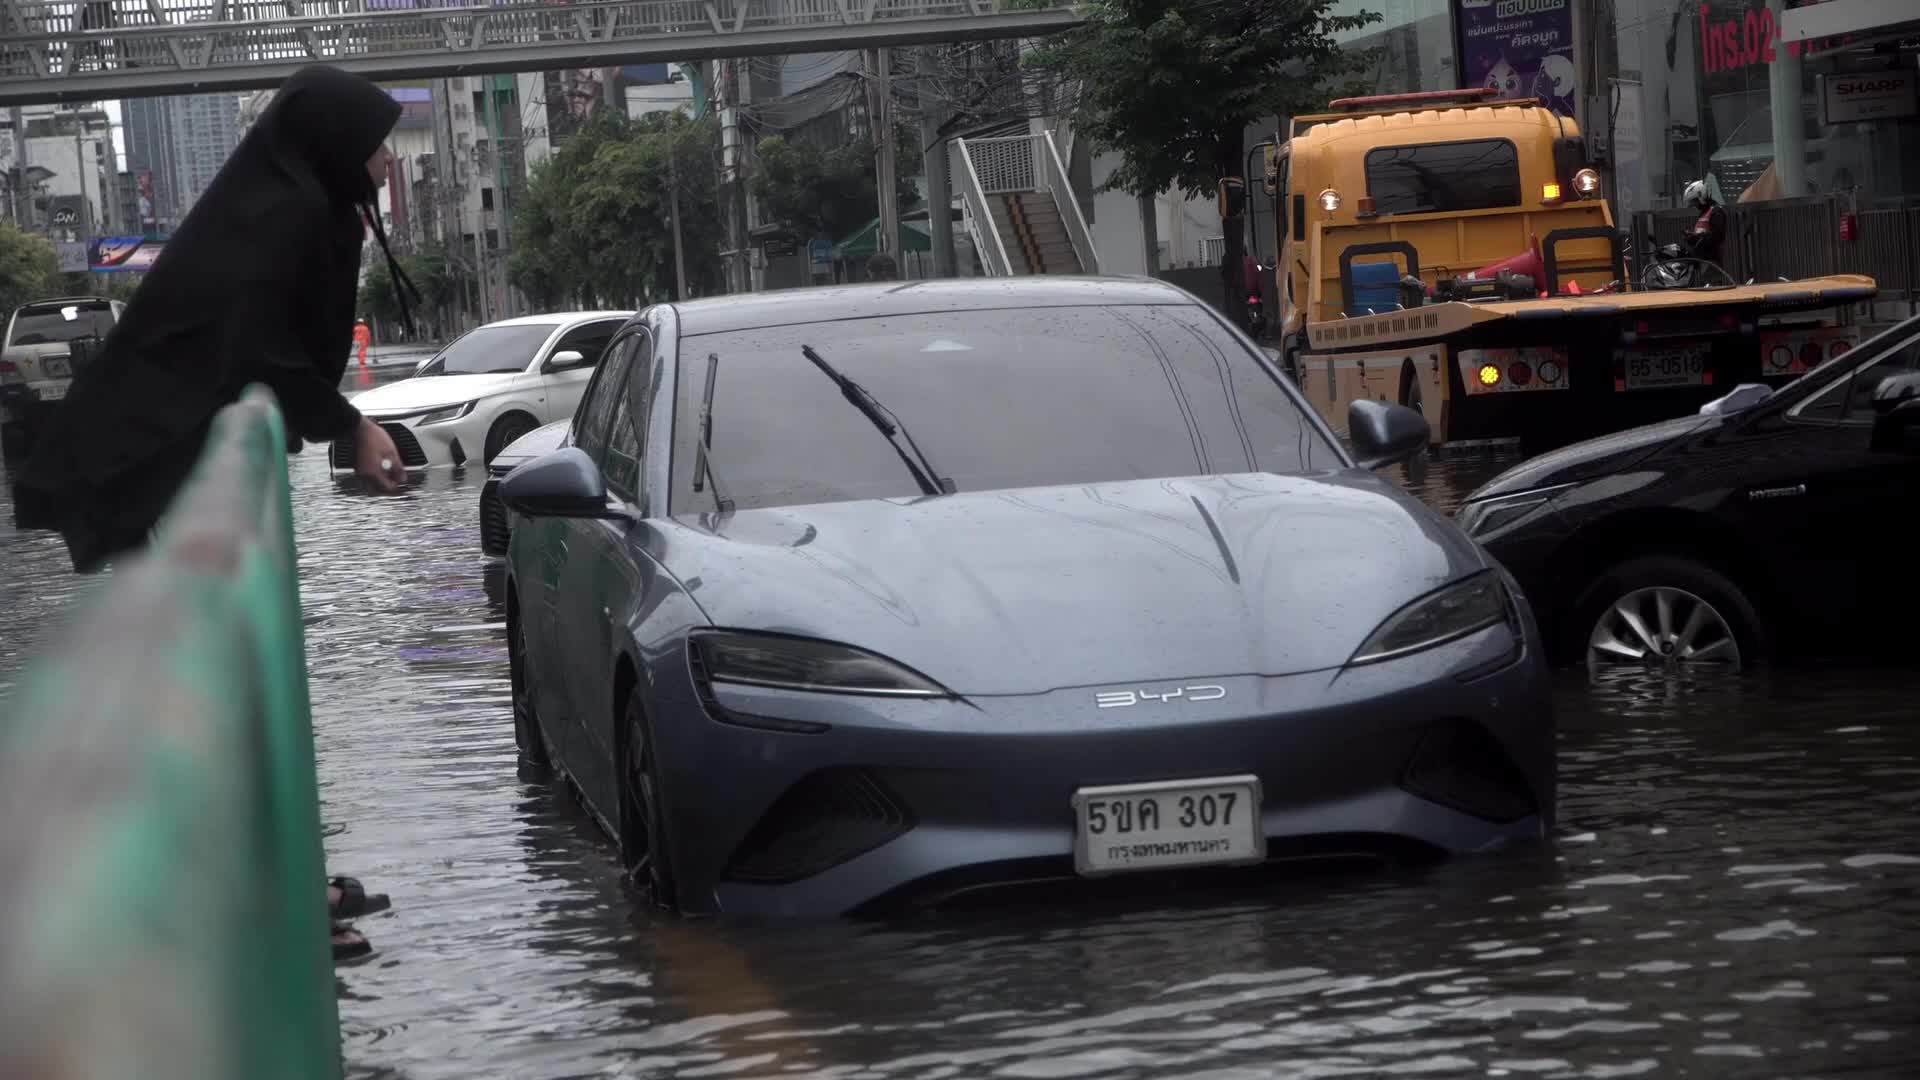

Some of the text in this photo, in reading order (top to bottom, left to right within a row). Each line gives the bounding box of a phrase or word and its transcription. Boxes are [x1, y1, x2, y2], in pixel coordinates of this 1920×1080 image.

[1836, 79, 1905, 95] SHARP
[1095, 684, 1226, 708] BYD
[1087, 792, 1238, 834] 5ขค 307
[1108, 836, 1231, 862] กรุงเทพมหานคร
